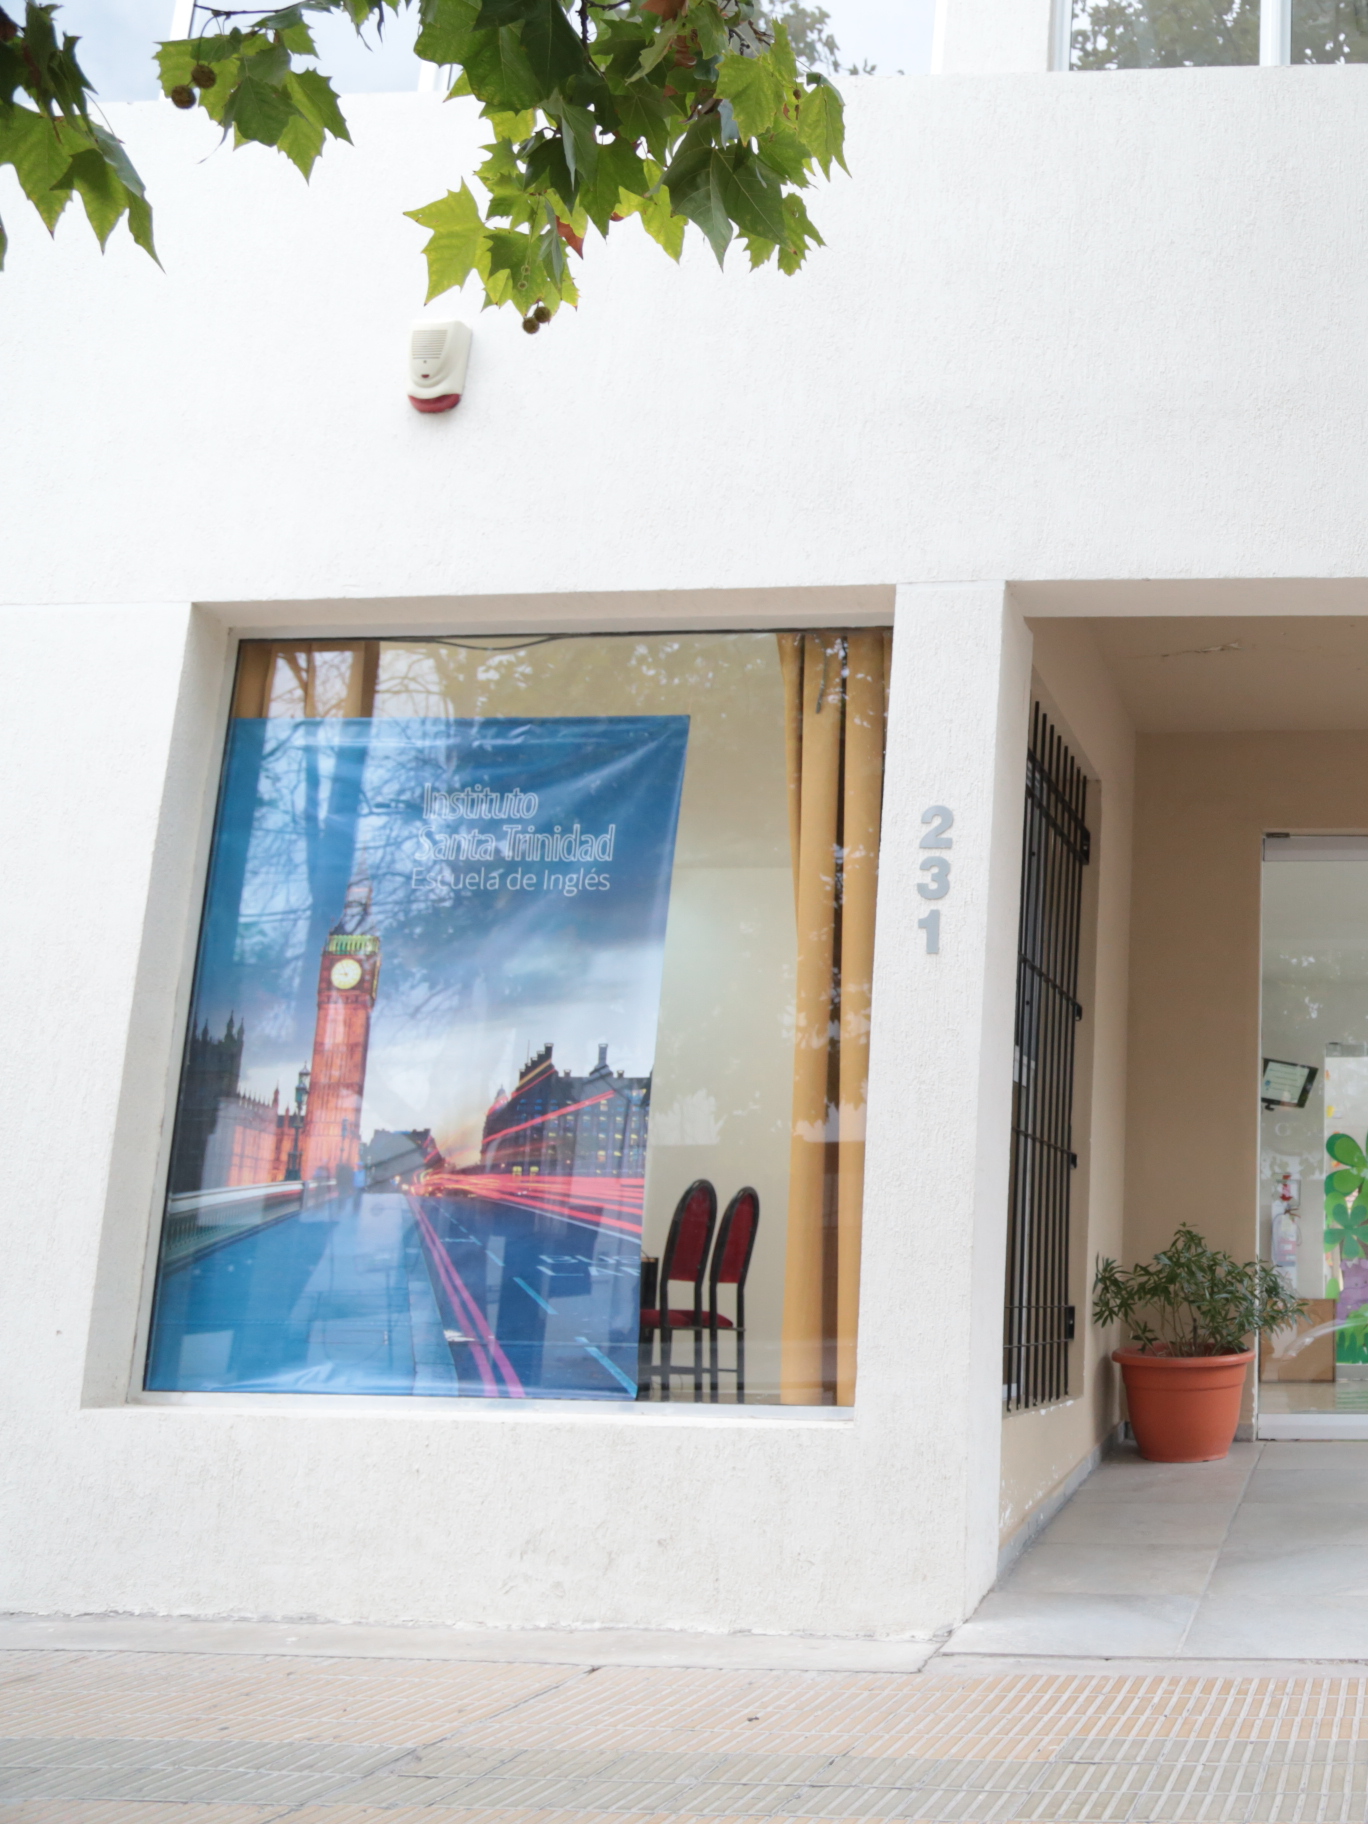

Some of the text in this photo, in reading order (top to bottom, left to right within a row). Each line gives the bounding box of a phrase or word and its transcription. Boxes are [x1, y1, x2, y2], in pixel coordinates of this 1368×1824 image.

[422, 782, 539, 819] Instituto
[414, 824, 616, 861] Santa Trinidad
[411, 867, 610, 897] Escuela de Inglés
